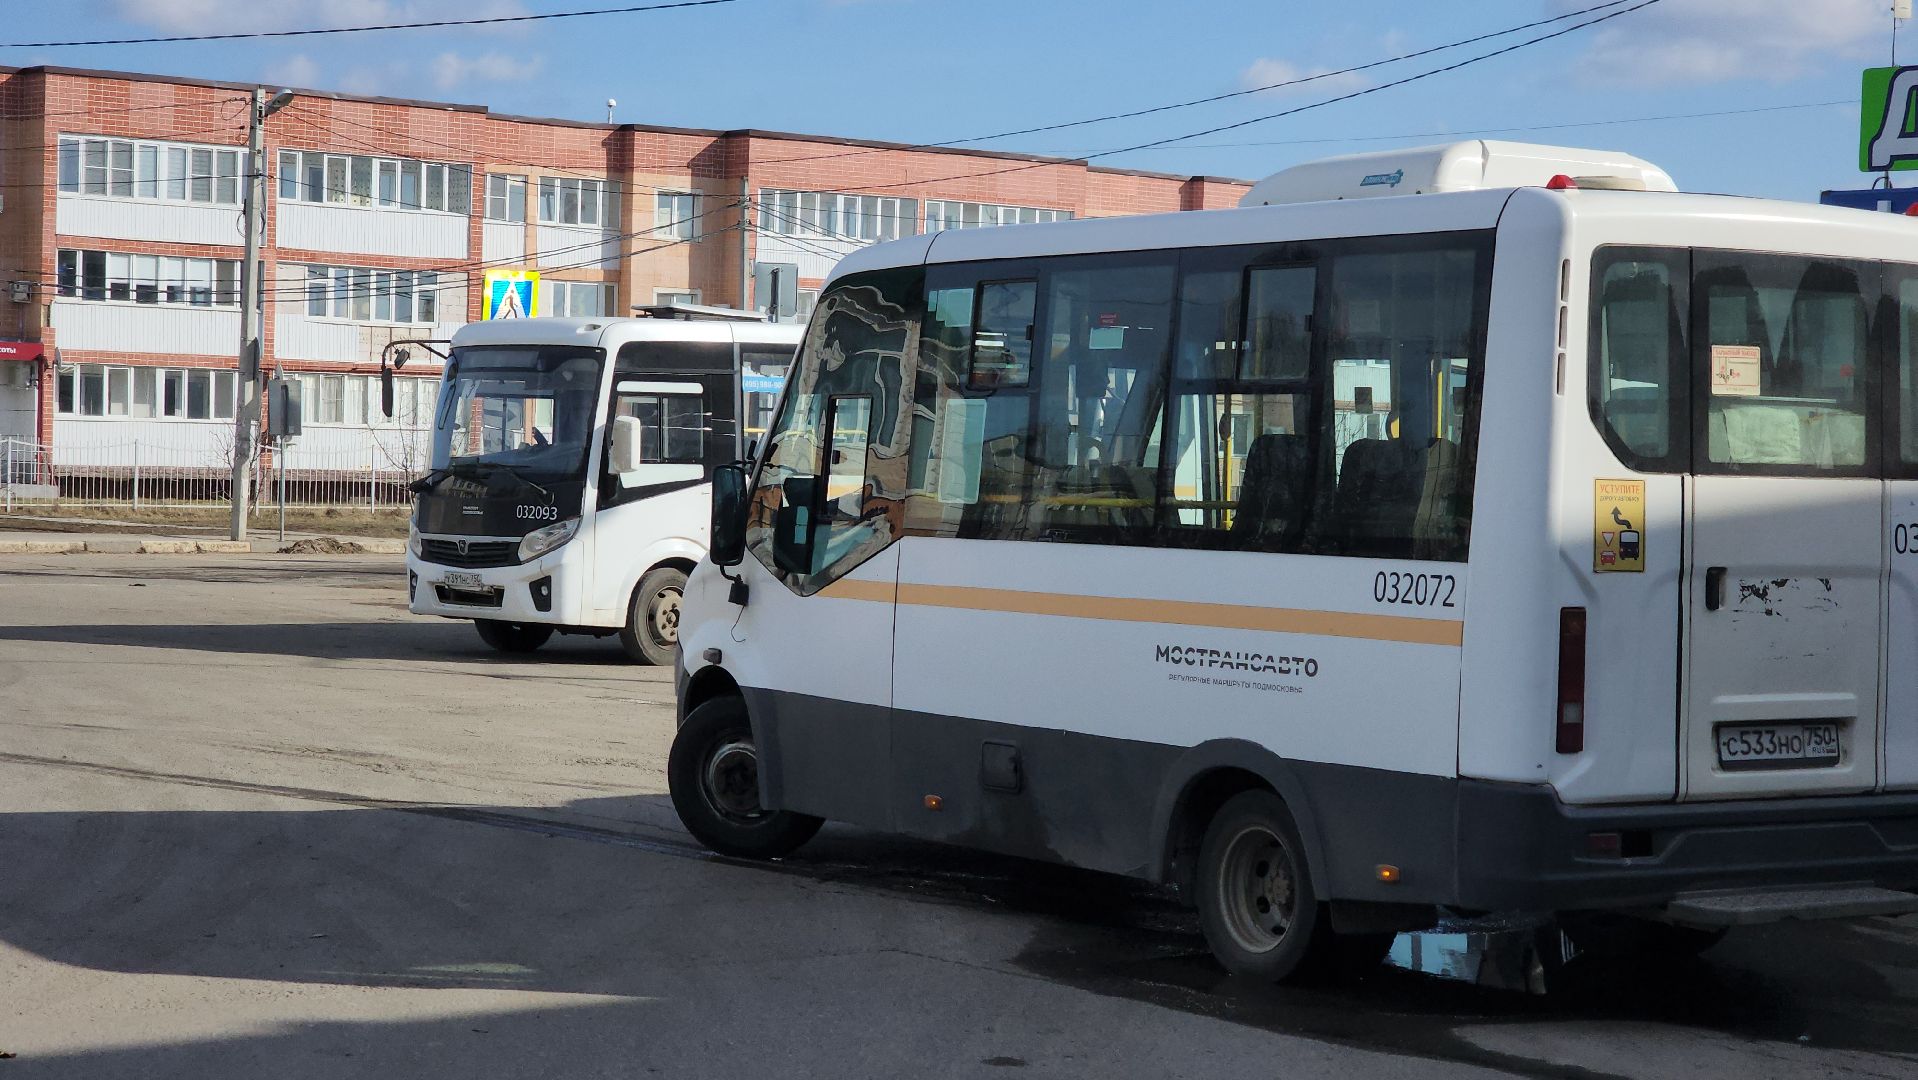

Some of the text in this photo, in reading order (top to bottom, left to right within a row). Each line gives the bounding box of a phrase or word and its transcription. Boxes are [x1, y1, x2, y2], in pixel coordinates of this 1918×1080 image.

[1600, 484, 1640, 494] УСТУПИТЕ
[516, 505, 558, 520] 032093
[1374, 571, 1455, 607] 032072
[1156, 644, 1318, 677] МОСТРАНСАВТО
[1168, 674, 1302, 694] РЕГУЛЯРНЫЕ МАРШРУТЫ ПОДМОСКОВЬЯ
